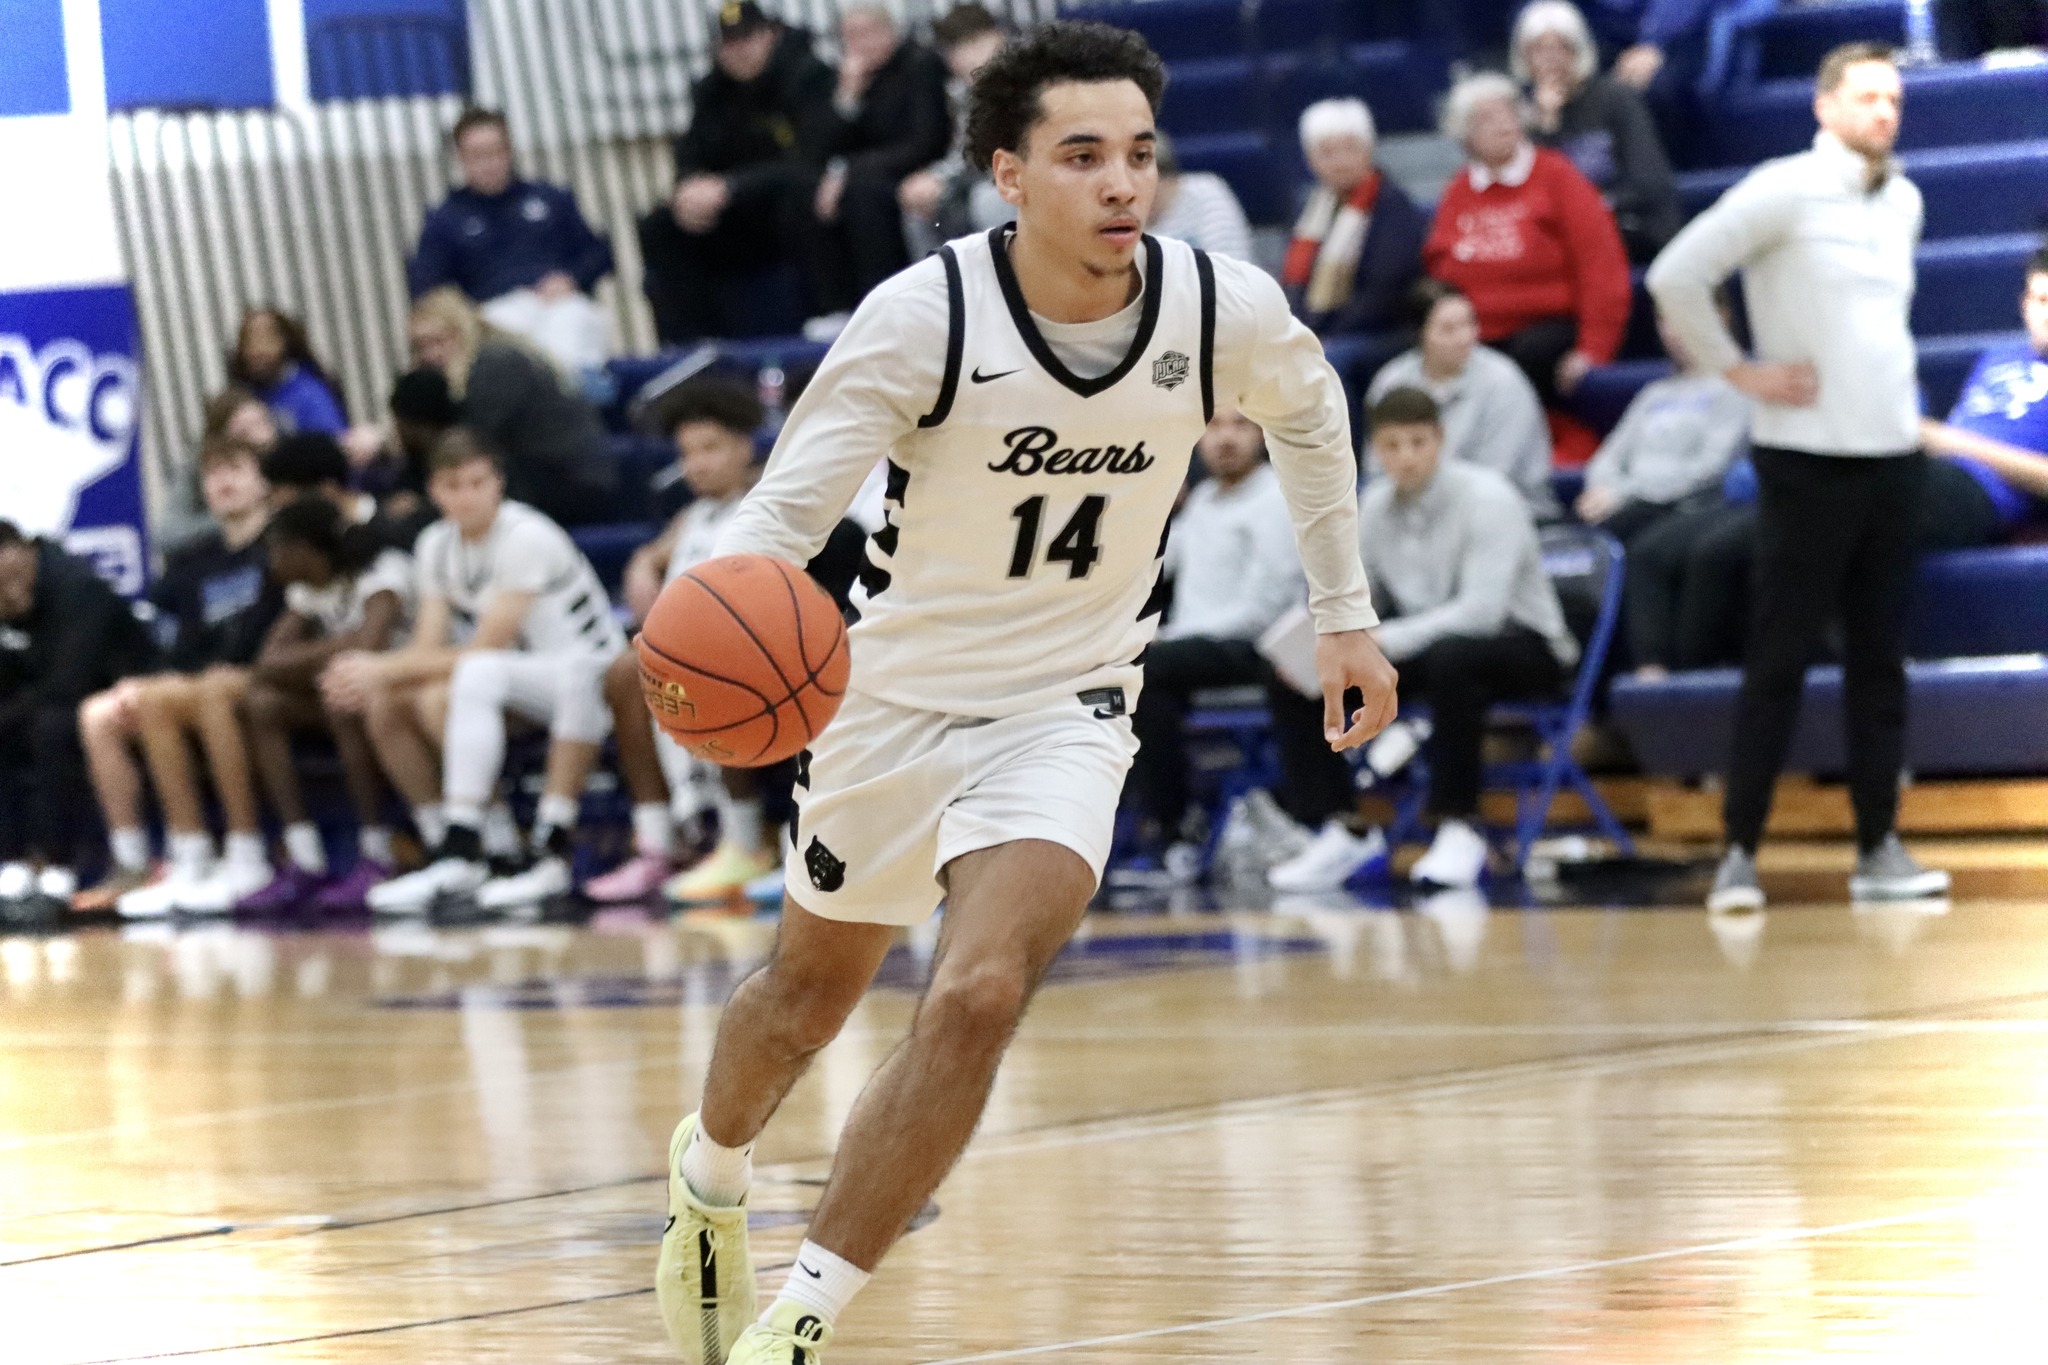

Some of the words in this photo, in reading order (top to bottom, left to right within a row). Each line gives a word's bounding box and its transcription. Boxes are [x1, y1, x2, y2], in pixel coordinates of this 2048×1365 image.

[1154, 358, 1186, 381] NJCAA
[987, 425, 1156, 477] Bears
[1004, 492, 1111, 582] 14
